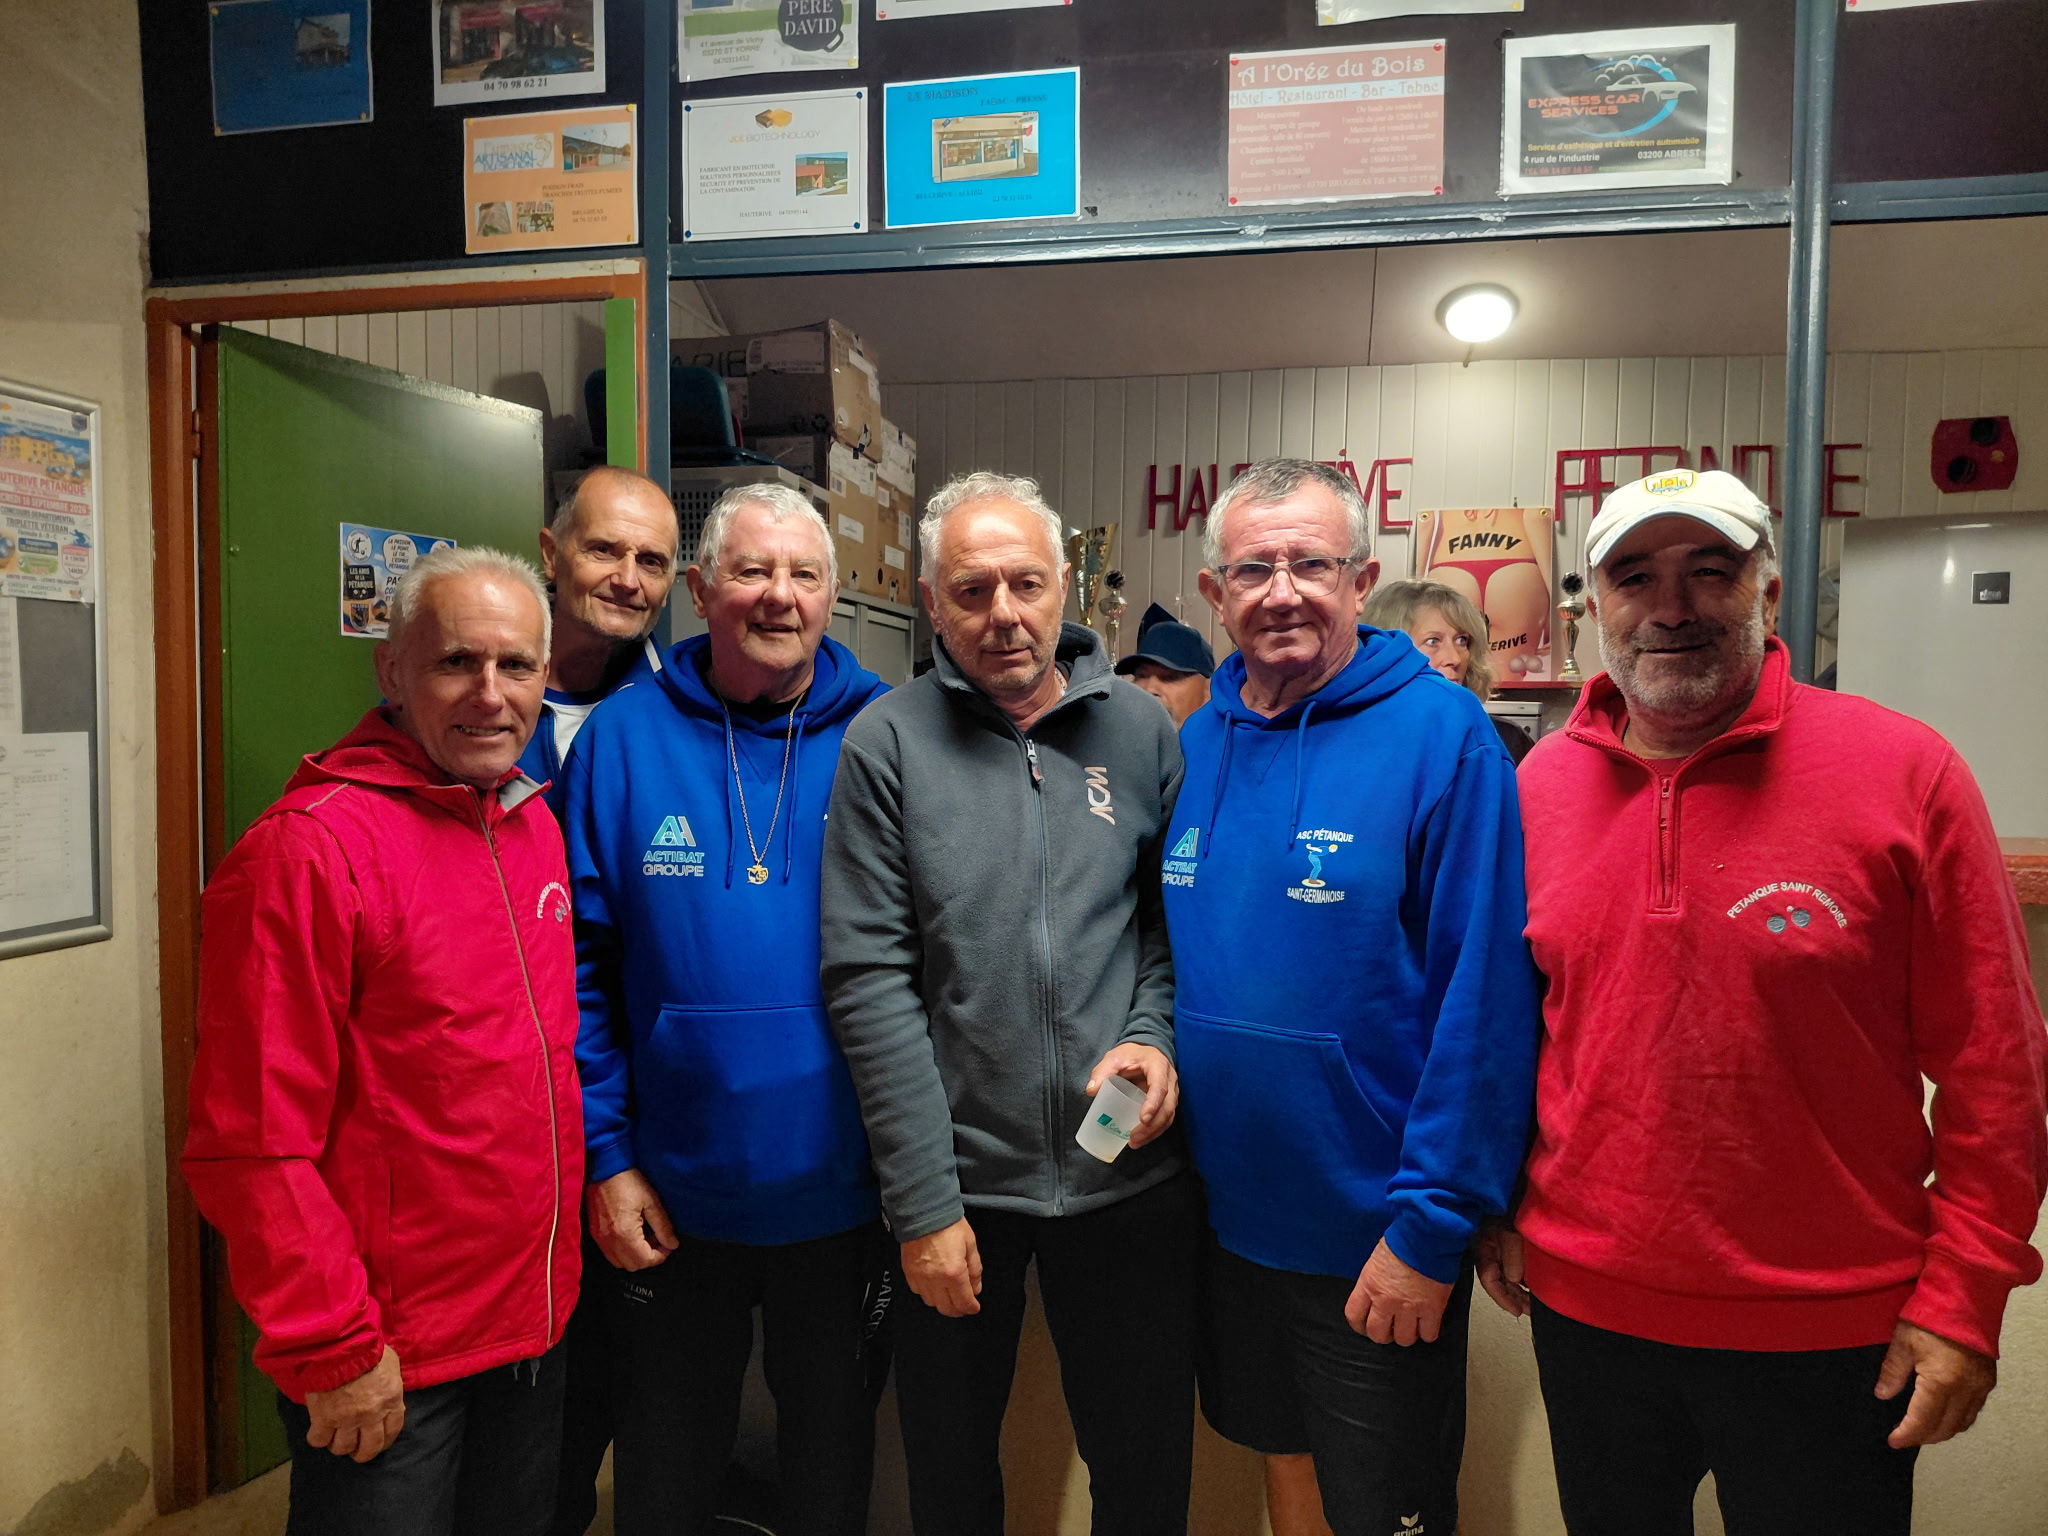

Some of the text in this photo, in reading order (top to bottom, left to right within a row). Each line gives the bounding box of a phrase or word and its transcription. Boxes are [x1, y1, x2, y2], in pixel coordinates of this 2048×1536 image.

[785, 18, 836, 36] DAVID
[1238, 56, 1425, 86] A l'Orée du Bois
[484, 78, 547, 91] 04 70 98 62 21
[907, 88, 977, 102] LE MADISON
[1231, 91, 1264, 106] Hôtel
[1277, 86, 1347, 104] Restaurant
[1361, 84, 1385, 99] Bar
[1399, 81, 1439, 95] Tabac
[1528, 94, 1640, 108] EXPRESS CAR
[1541, 105, 1618, 118] SERVICES
[746, 130, 821, 142] BIOTECHNOLOGY
[1557, 142, 1603, 150] d'esthétique
[1614, 139, 1654, 148] d'entretien
[1656, 137, 1699, 146] automobile
[475, 151, 537, 163] ARTISANAL
[1546, 155, 1557, 163] de
[1559, 154, 1600, 162] l'industrie
[1638, 149, 1700, 159] 03200 ABREST
[700, 165, 731, 173] FABRICANT
[1448, 532, 1523, 555] FANNY
[1296, 828, 1354, 843] ASC PÉTANQUE
[643, 850, 705, 863] ACTIBAT
[643, 864, 704, 877] GROUPE
[1162, 860, 1198, 874] ACTIBAT
[1287, 887, 1345, 903] SAINT-GERMANOISE
[1727, 881, 1848, 929] PETANQUE SAINT REMOISE
[1394, 1525, 1424, 1536] erima
